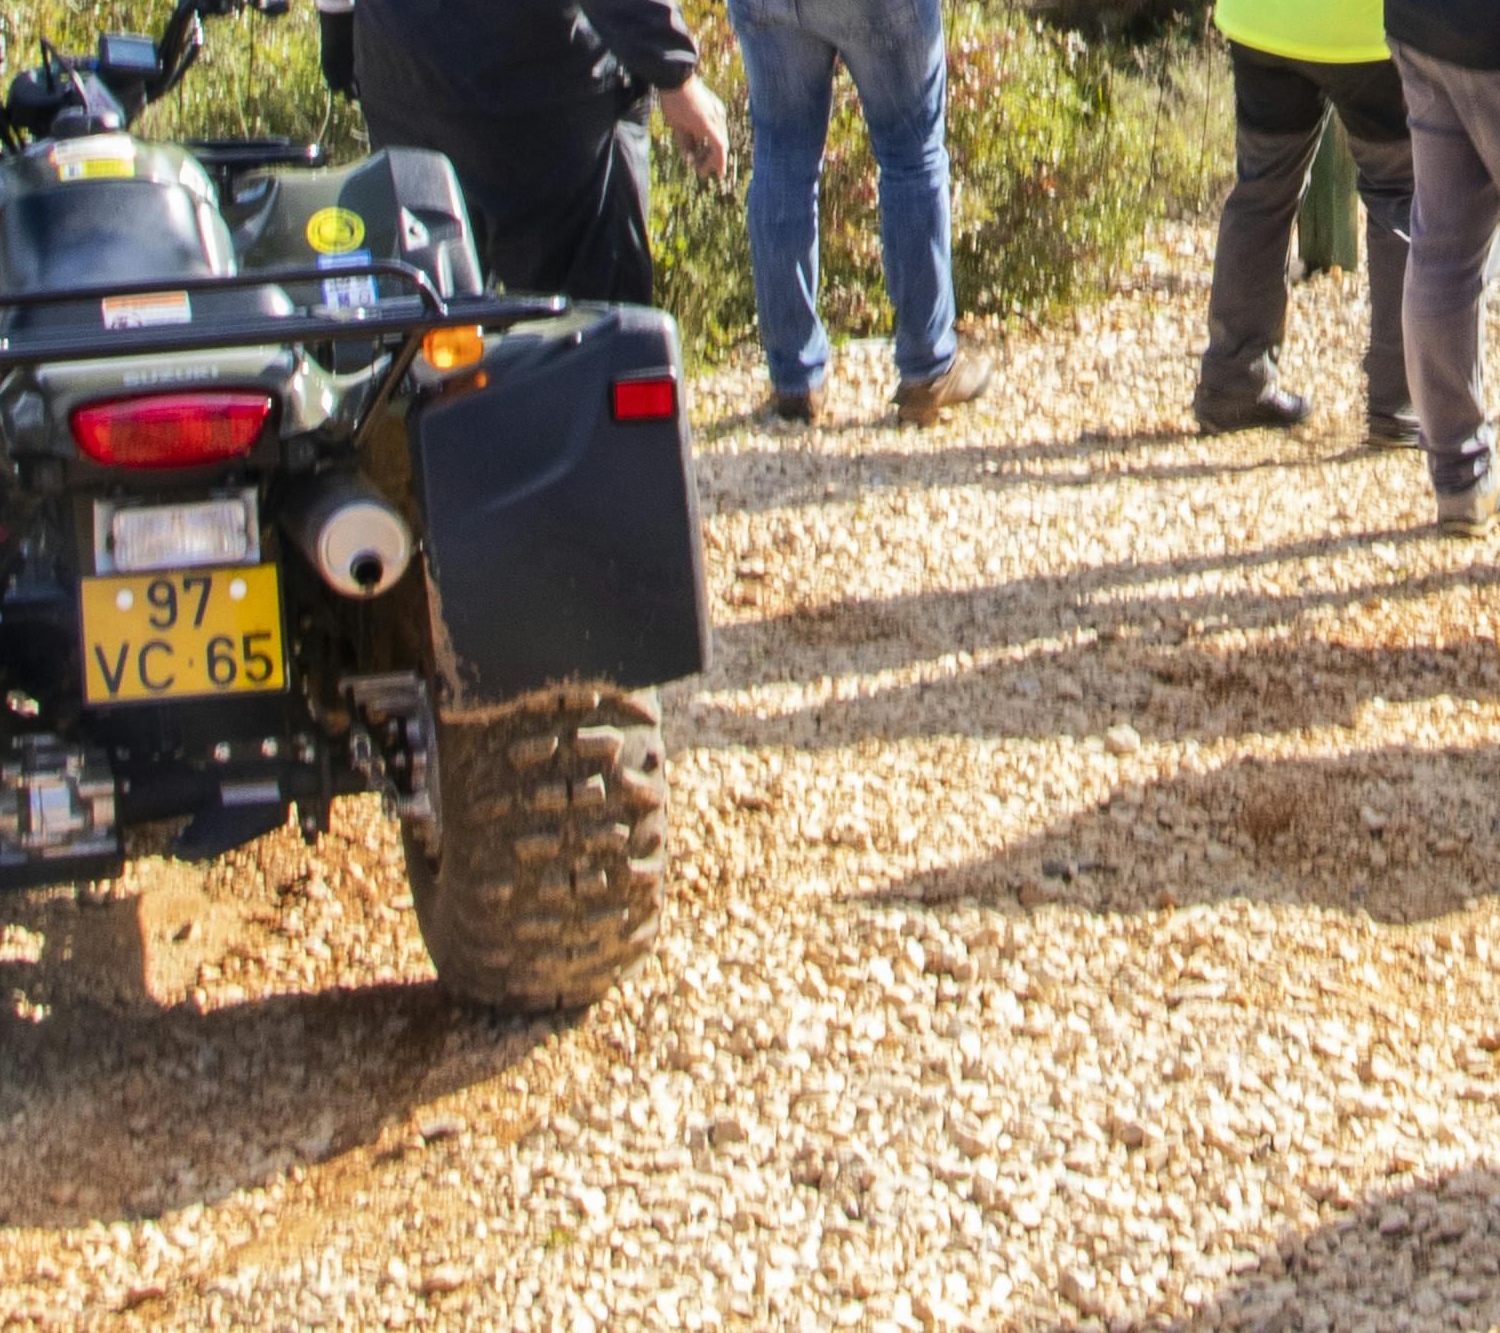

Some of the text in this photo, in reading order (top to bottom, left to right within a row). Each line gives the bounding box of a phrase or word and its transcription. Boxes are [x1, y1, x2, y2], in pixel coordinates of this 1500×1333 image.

[147, 576, 212, 630] 97
[94, 631, 274, 696] VC 65
